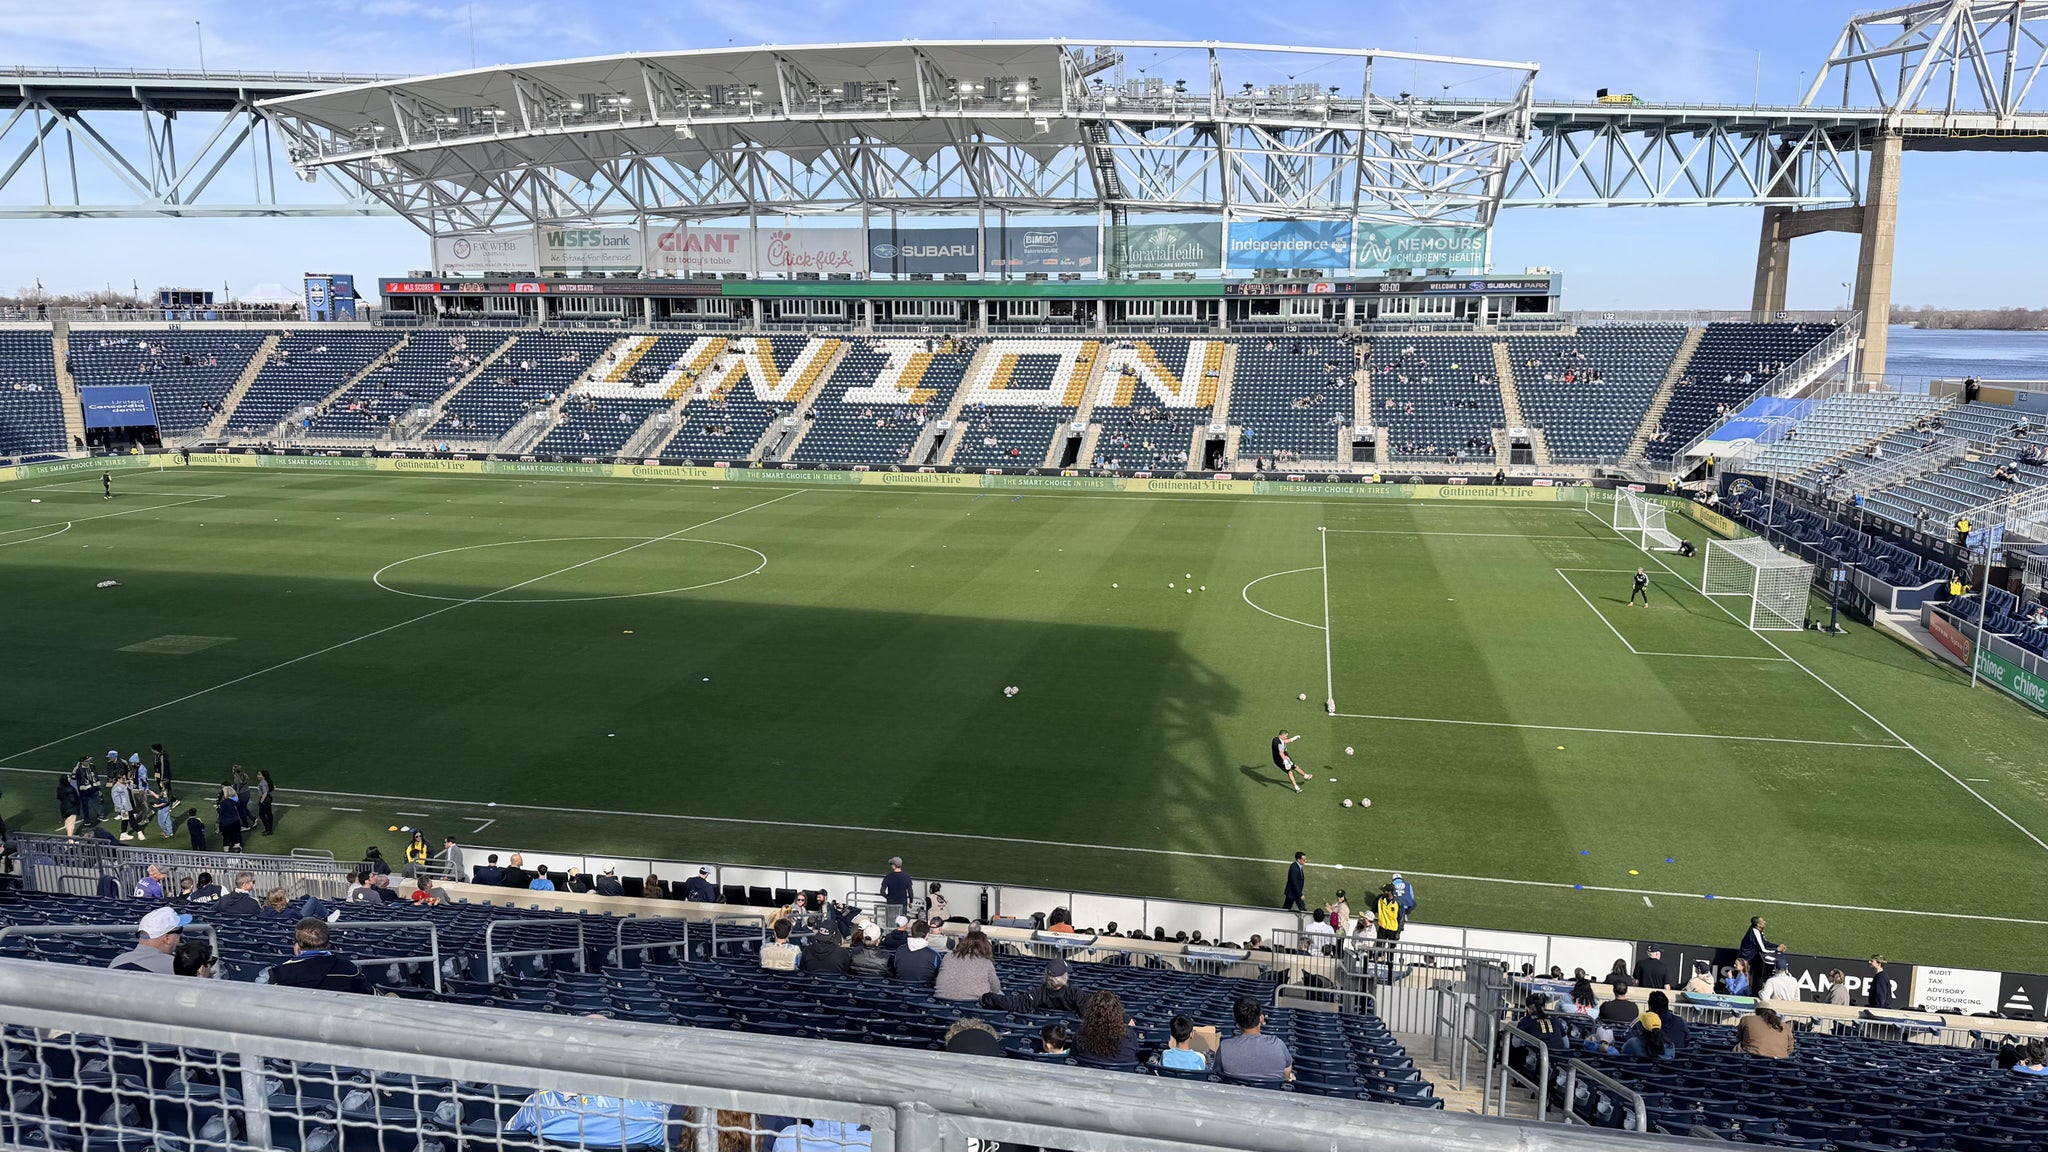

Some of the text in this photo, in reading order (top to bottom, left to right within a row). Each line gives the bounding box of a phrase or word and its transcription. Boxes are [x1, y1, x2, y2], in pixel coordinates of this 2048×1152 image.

[546, 230, 630, 247] WSFS bank
[657, 232, 740, 252] GIANT
[1026, 236, 1056, 244] BIMBO
[1397, 238, 1482, 250] NEMOURS
[490, 242, 516, 251] WEBB
[902, 244, 975, 257] SUBARU
[1231, 238, 1328, 252] Independence
[1121, 242, 1204, 262] MoraviaHealth
[1396, 252, 1480, 262] CHILDREN'S HEALTH
[679, 256, 708, 265] today's
[1380, 283, 1400, 292] 30:00
[575, 336, 1224, 407] UNION
[173, 454, 241, 464] Cotinental Tire
[394, 459, 465, 470] Continental Tire
[632, 466, 707, 477] Continental Tire
[883, 472, 961, 484] Continental Tire
[1045, 479, 1072, 487] CHOICE
[1149, 478, 1232, 491] Continental Tire
[1324, 486, 1353, 494] CHOICE
[1439, 486, 1534, 498] Continental Tire
[2014, 672, 2044, 703] chime
[1926, 996, 1981, 1005] OUTSOURCING
